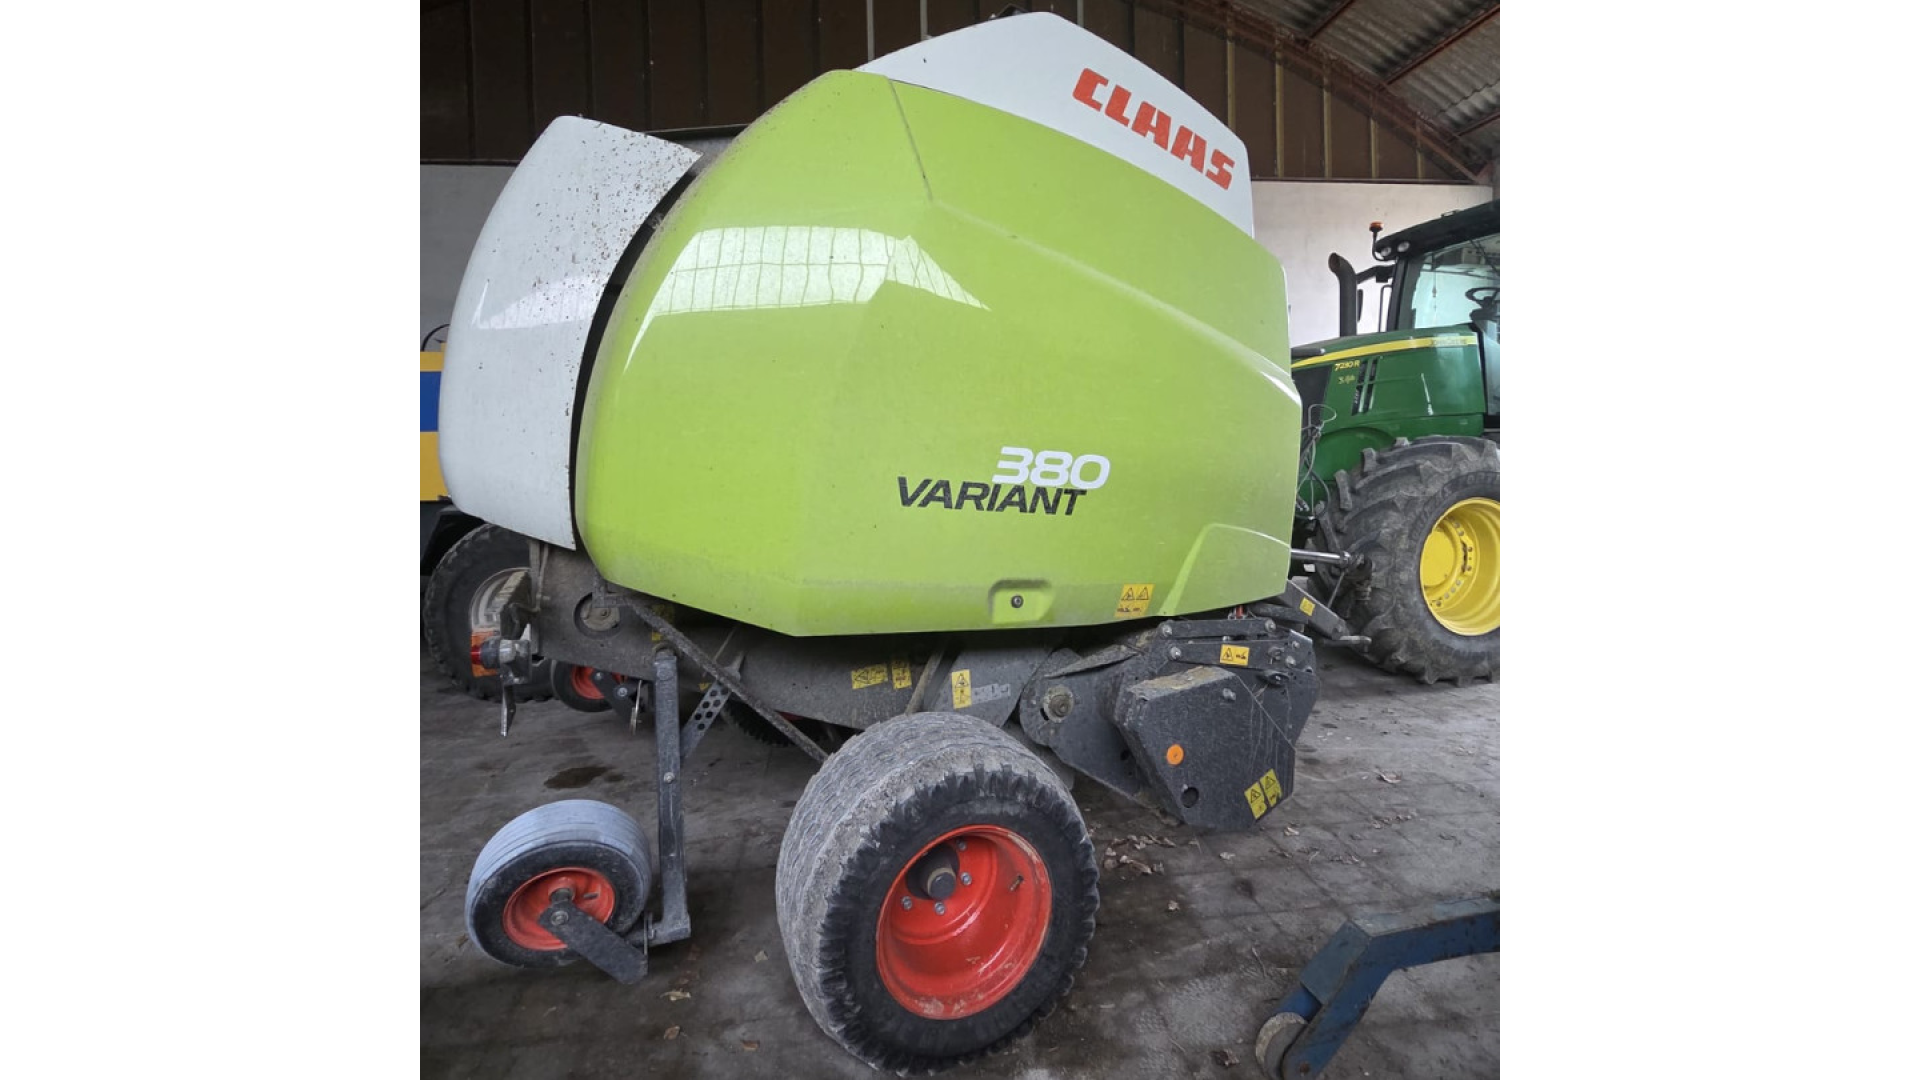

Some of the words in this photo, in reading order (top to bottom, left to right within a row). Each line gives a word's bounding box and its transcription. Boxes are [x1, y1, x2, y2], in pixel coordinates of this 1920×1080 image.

[1072, 68, 1236, 190] CLAAS
[991, 446, 1111, 490] 380
[897, 476, 1087, 516] VARIANT
